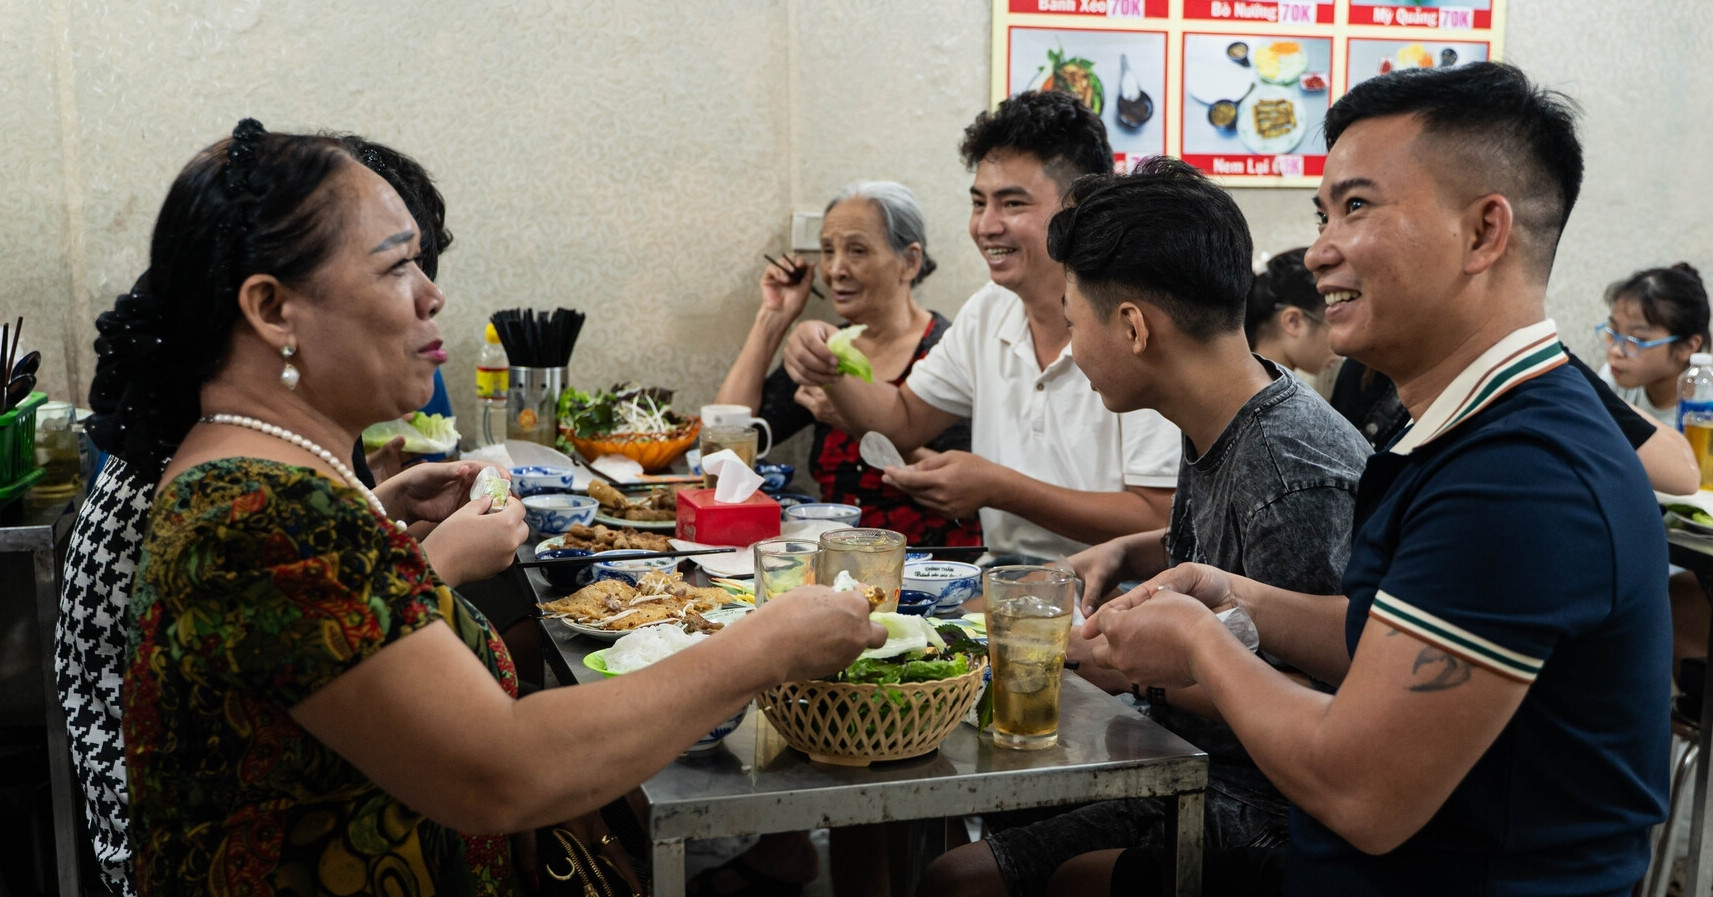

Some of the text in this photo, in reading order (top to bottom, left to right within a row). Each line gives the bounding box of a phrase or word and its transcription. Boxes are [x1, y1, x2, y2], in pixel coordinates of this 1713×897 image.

[1111, 0, 1141, 16] 70K
[1282, 3, 1311, 22] 70K
[1442, 10, 1470, 28] 70K
[1212, 157, 1244, 174] Nem
